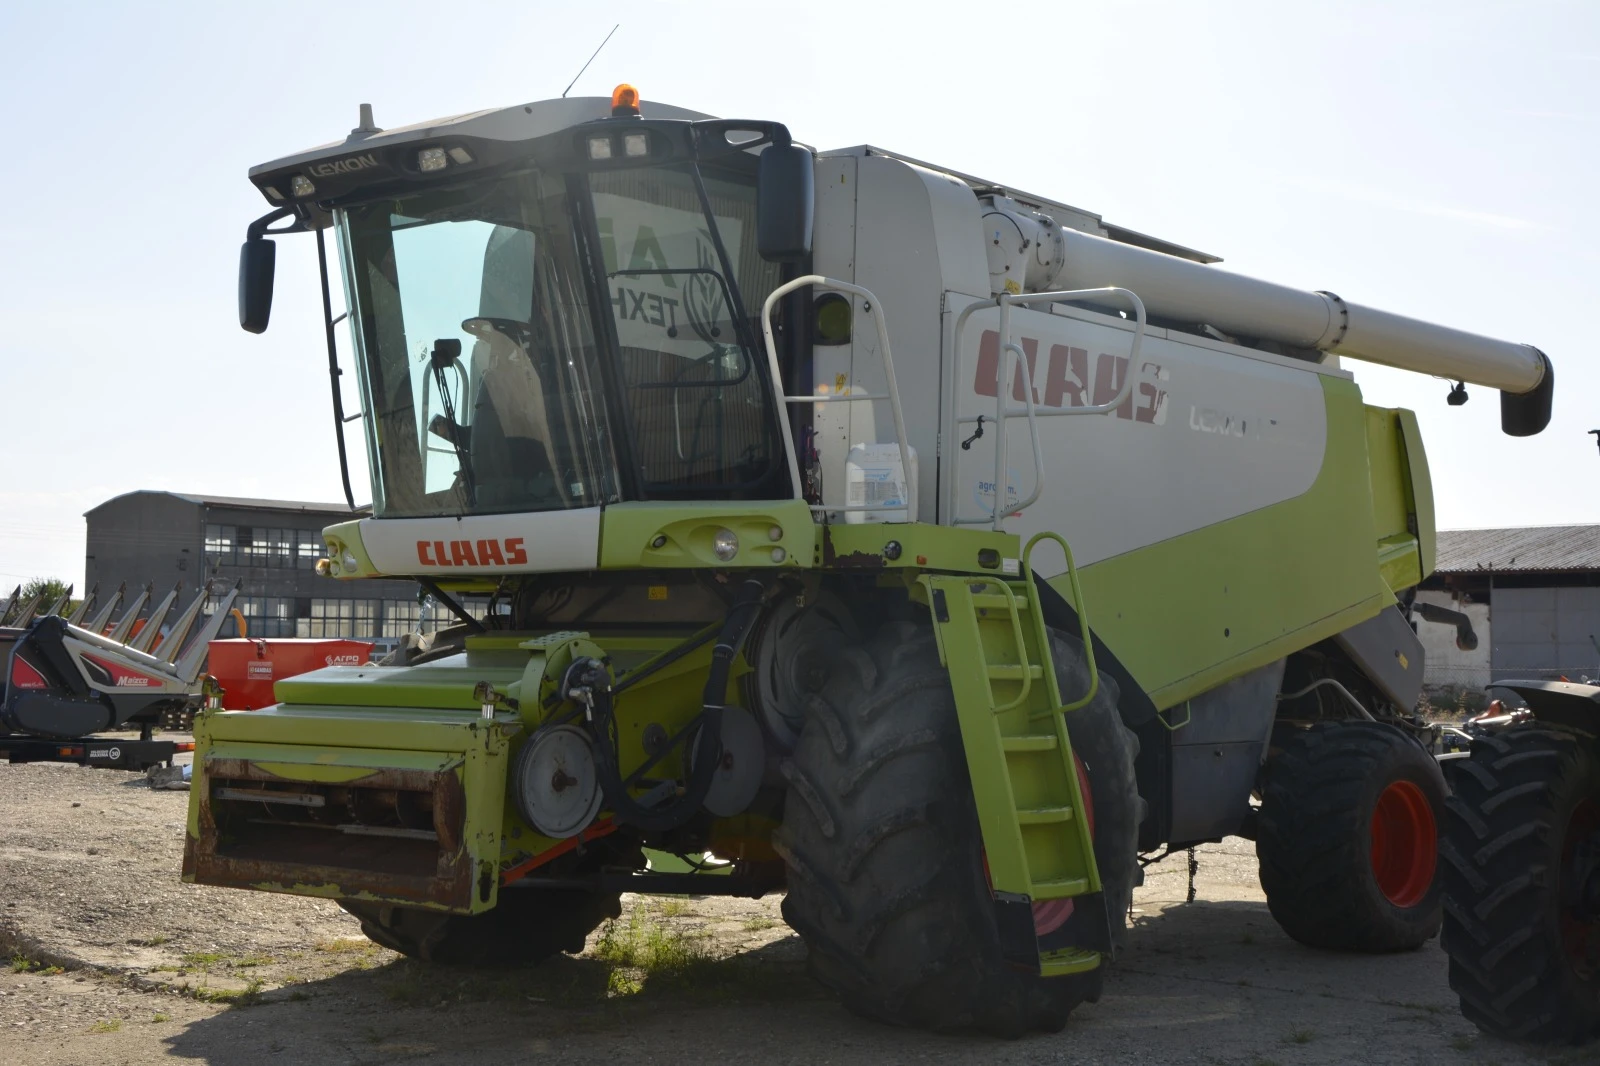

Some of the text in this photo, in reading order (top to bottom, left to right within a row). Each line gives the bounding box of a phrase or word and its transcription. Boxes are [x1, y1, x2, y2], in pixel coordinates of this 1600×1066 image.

[309, 154, 378, 176] LEXION
[973, 329, 1168, 425] CLAAS
[416, 537, 528, 567] CLAAS
[116, 675, 149, 686] Maizco
